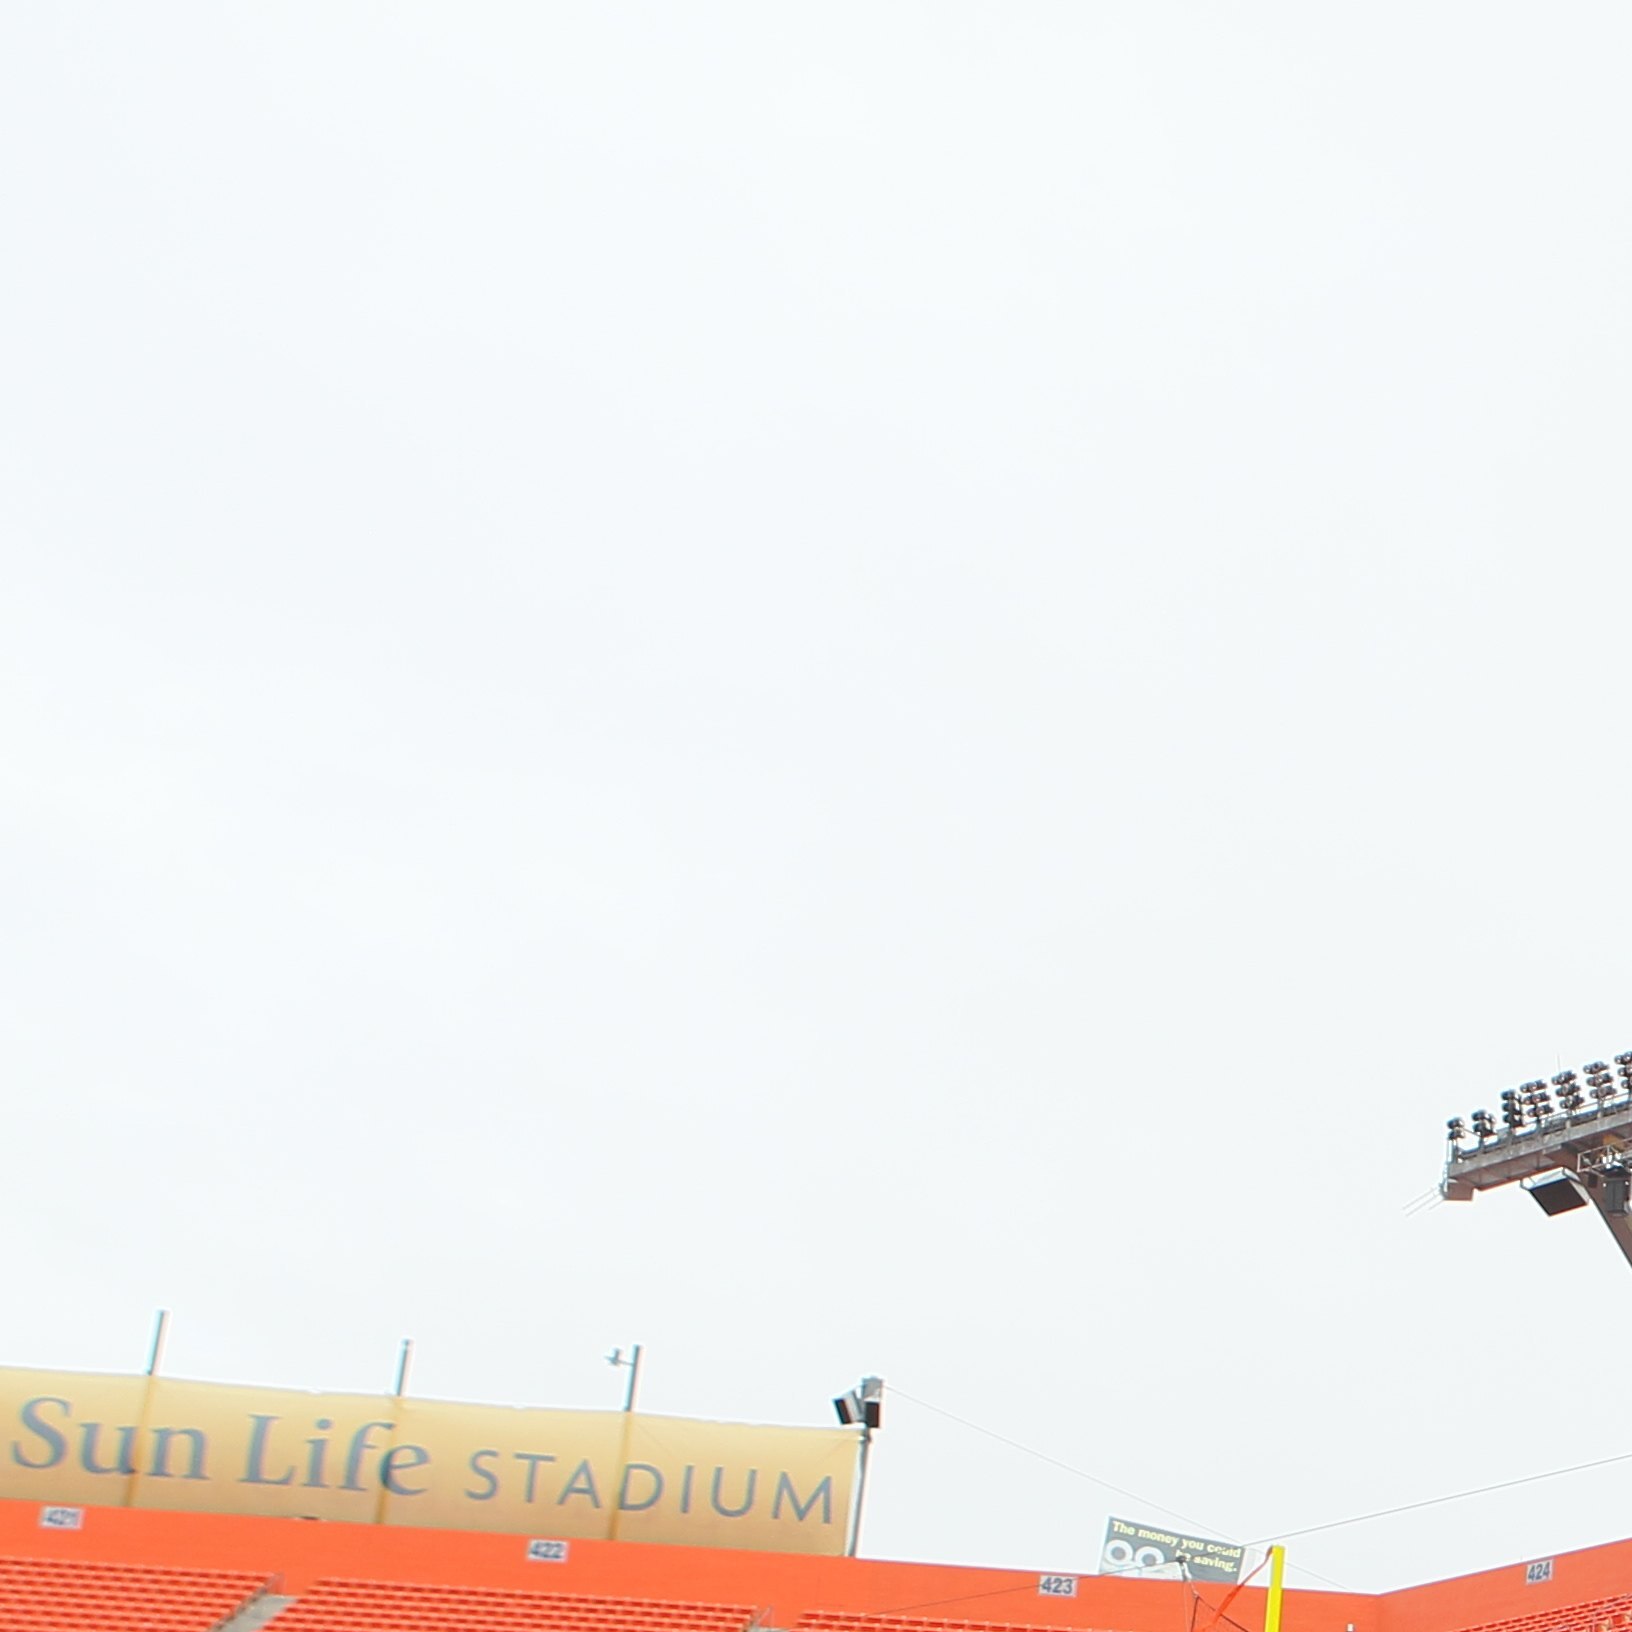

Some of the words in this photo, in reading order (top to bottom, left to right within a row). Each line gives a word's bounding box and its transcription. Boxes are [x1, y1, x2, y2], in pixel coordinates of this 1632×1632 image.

[10, 1395, 212, 1482] Sun
[238, 1412, 431, 1497] Life
[464, 1449, 836, 1526] STADIUM
[1112, 1520, 1135, 1536] The
[1138, 1529, 1180, 1548] money
[1181, 1538, 1205, 1552] you
[1207, 1543, 1242, 1558] could
[1041, 1574, 1074, 1596] 423
[1526, 1560, 1552, 1584] 424
